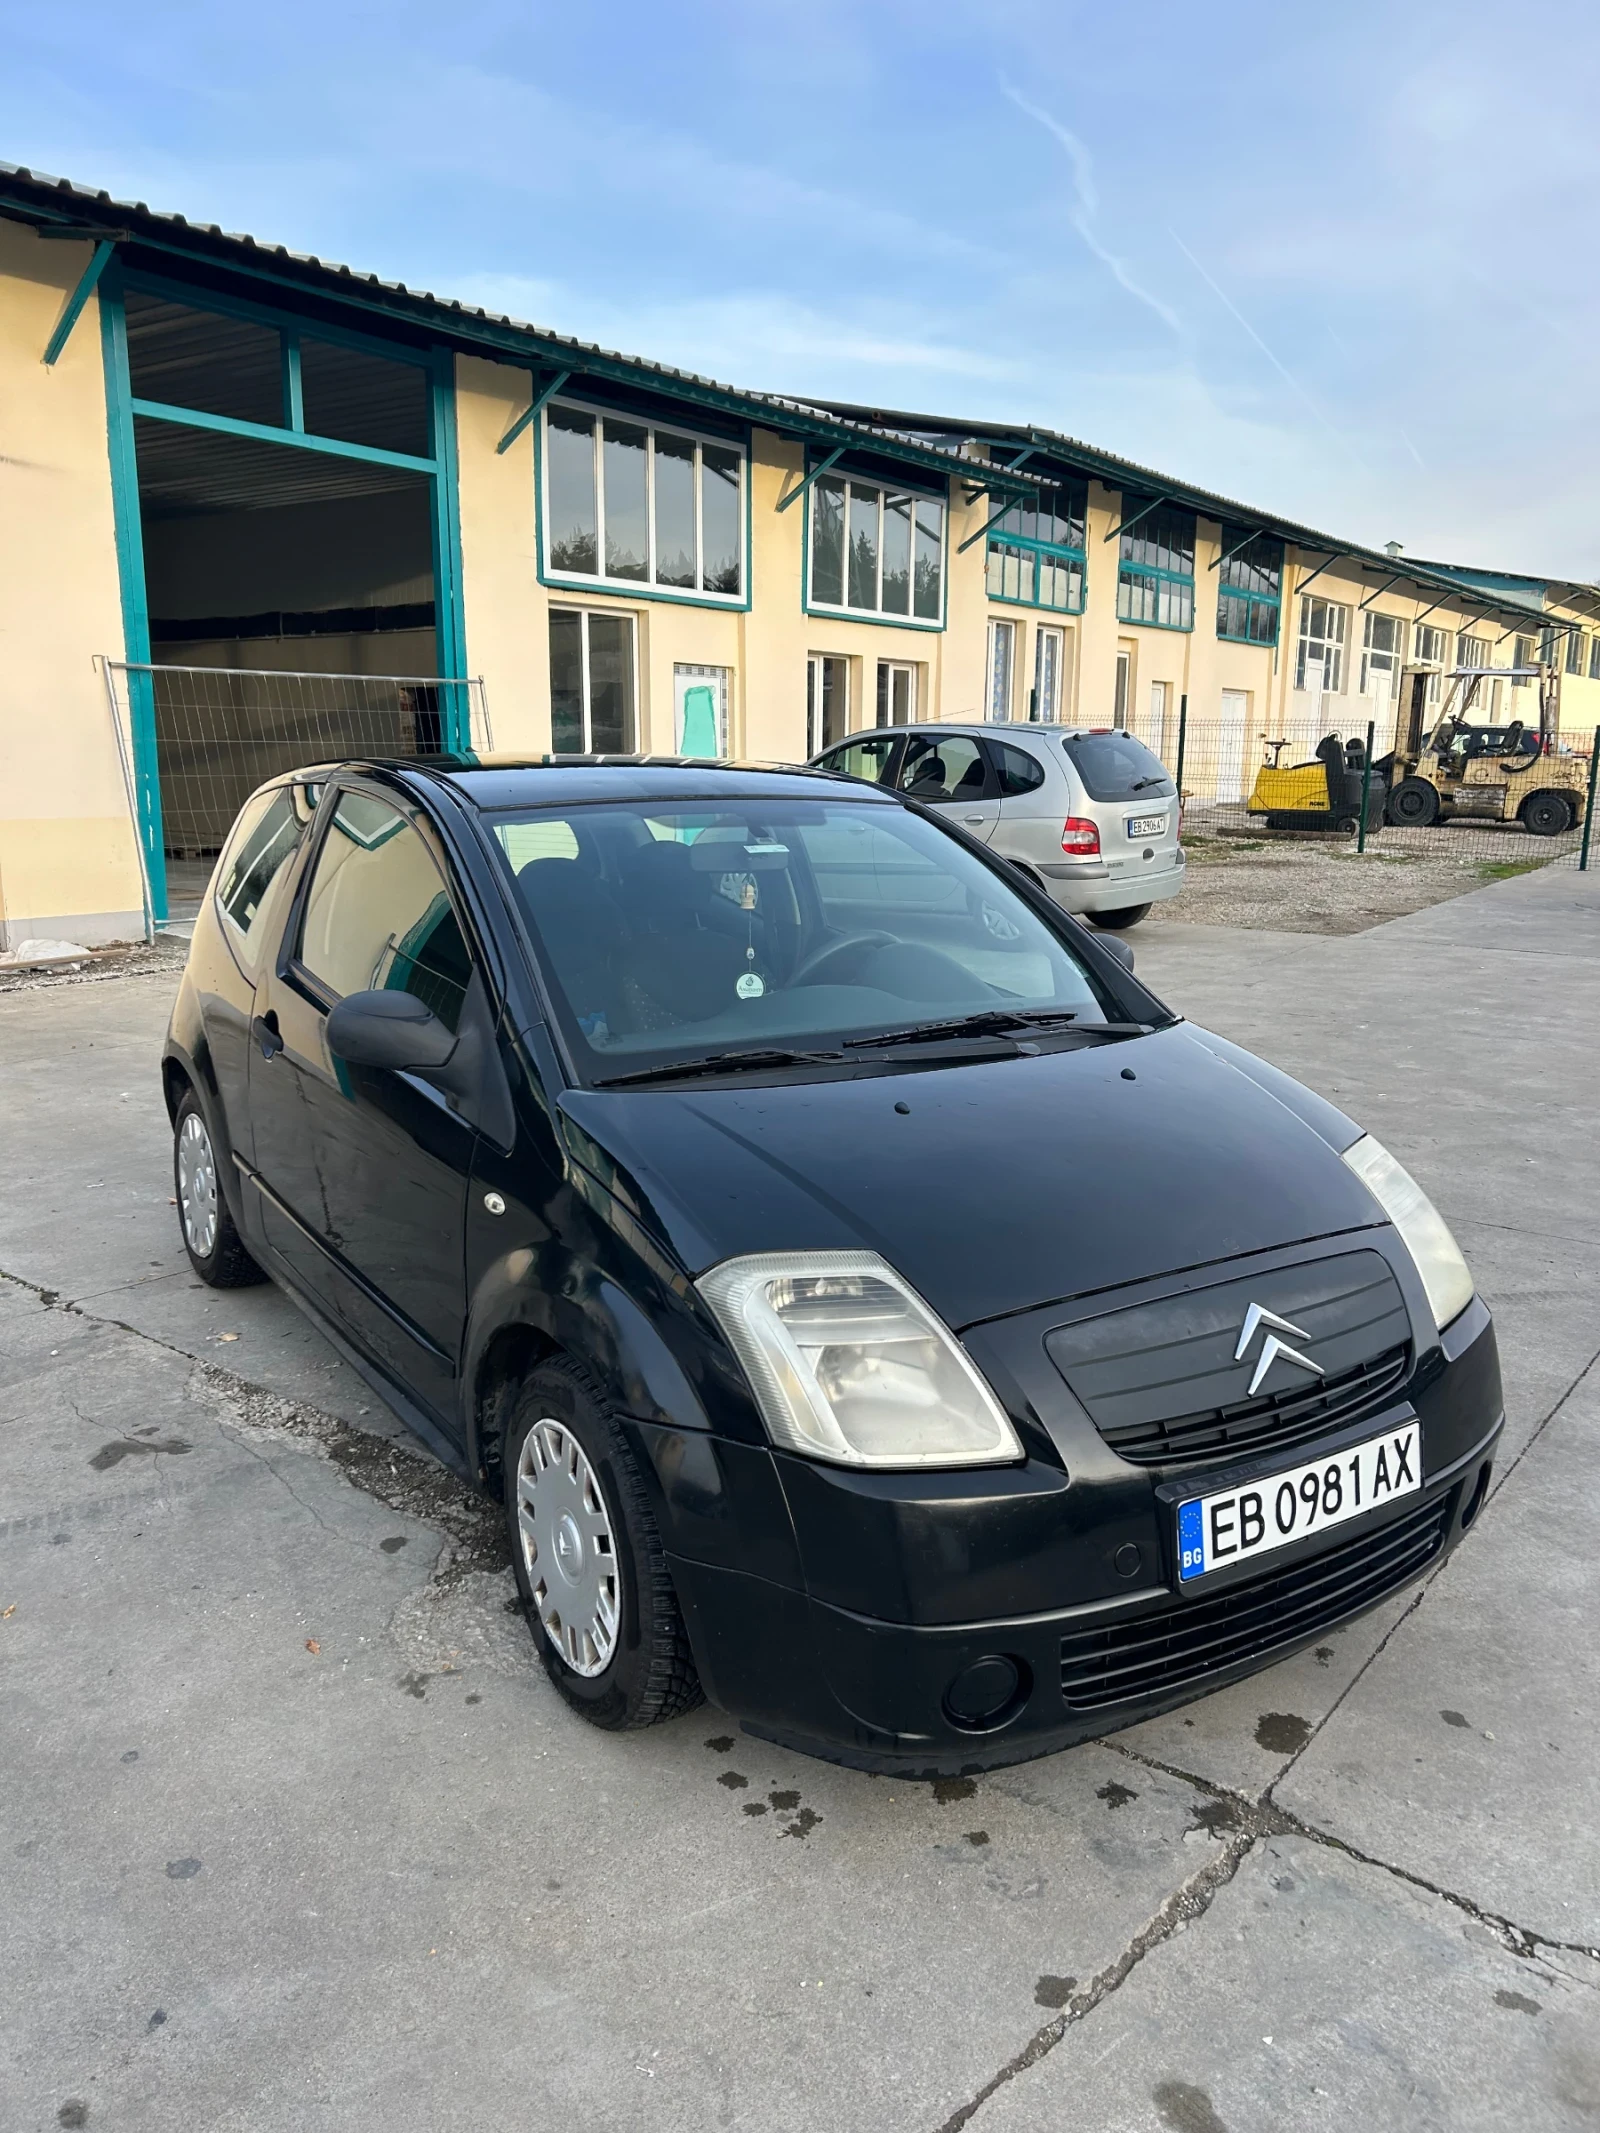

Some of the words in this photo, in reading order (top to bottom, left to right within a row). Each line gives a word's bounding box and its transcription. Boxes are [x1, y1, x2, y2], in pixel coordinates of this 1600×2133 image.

[1211, 1492, 1265, 1559] EB
[1275, 1454, 1361, 1535] 0981
[1373, 1432, 1414, 1499] AX
[1183, 1547, 1202, 1569] BG
